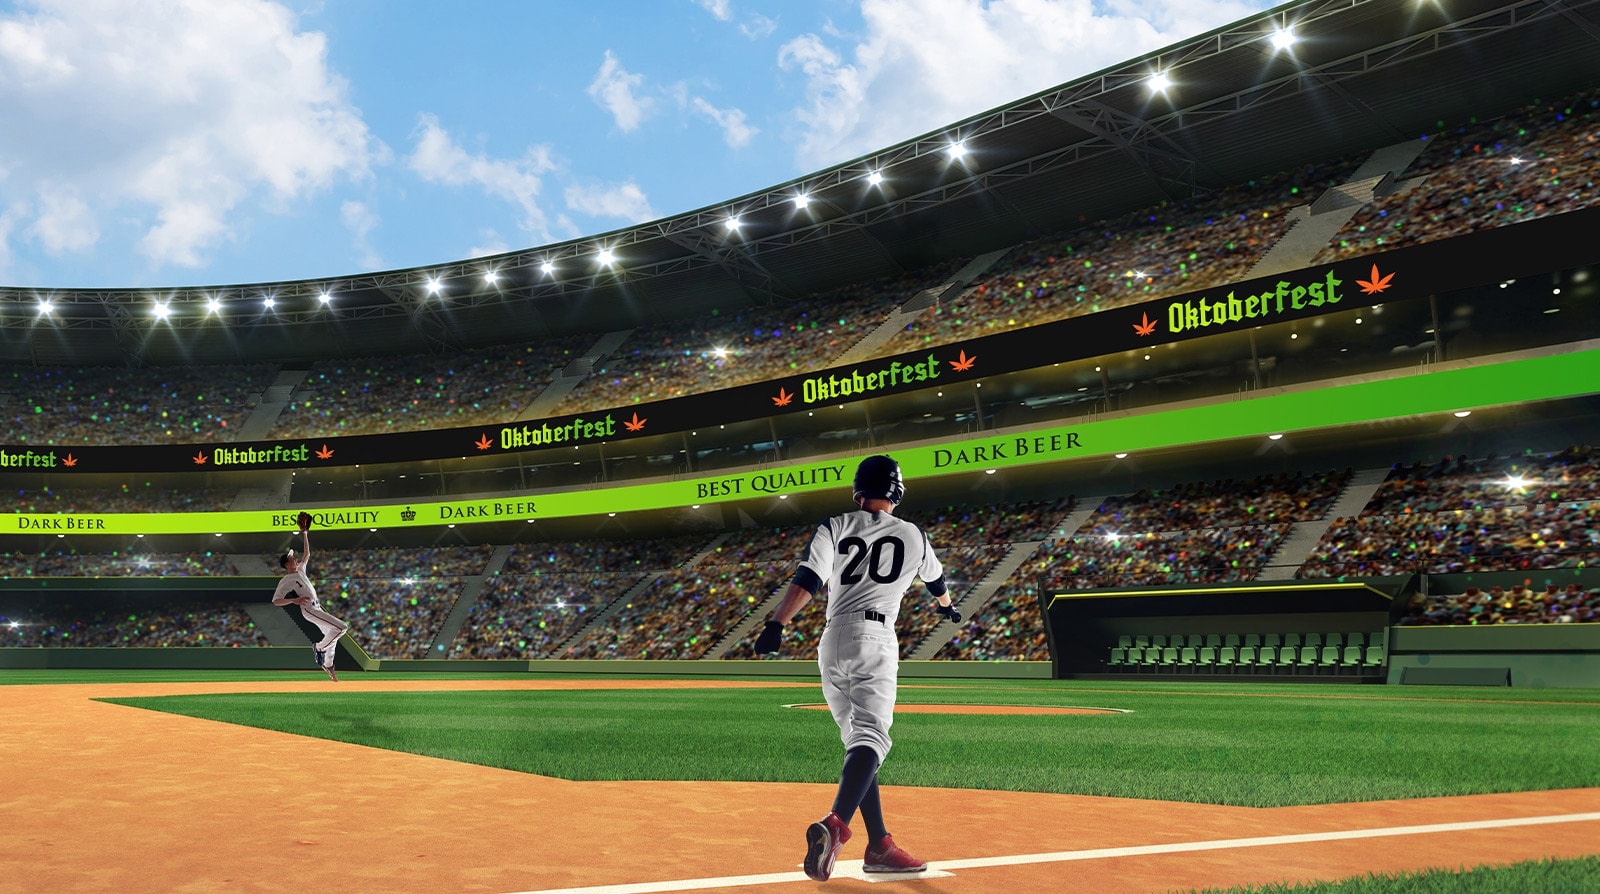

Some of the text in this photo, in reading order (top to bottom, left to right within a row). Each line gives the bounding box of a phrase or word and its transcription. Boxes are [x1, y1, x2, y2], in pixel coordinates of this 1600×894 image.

[1168, 269, 1343, 333] Oktoberfest
[802, 353, 940, 404] Oktoberfest
[500, 414, 616, 450] Oktoberfest
[213, 444, 309, 466] Oktoberfest
[697, 431, 1083, 499] BEST QUALITY DARK BEER
[18, 517, 106, 530] DARK BEER
[272, 502, 537, 527] BES QUALITY DARK BEER
[837, 535, 905, 585] 20
